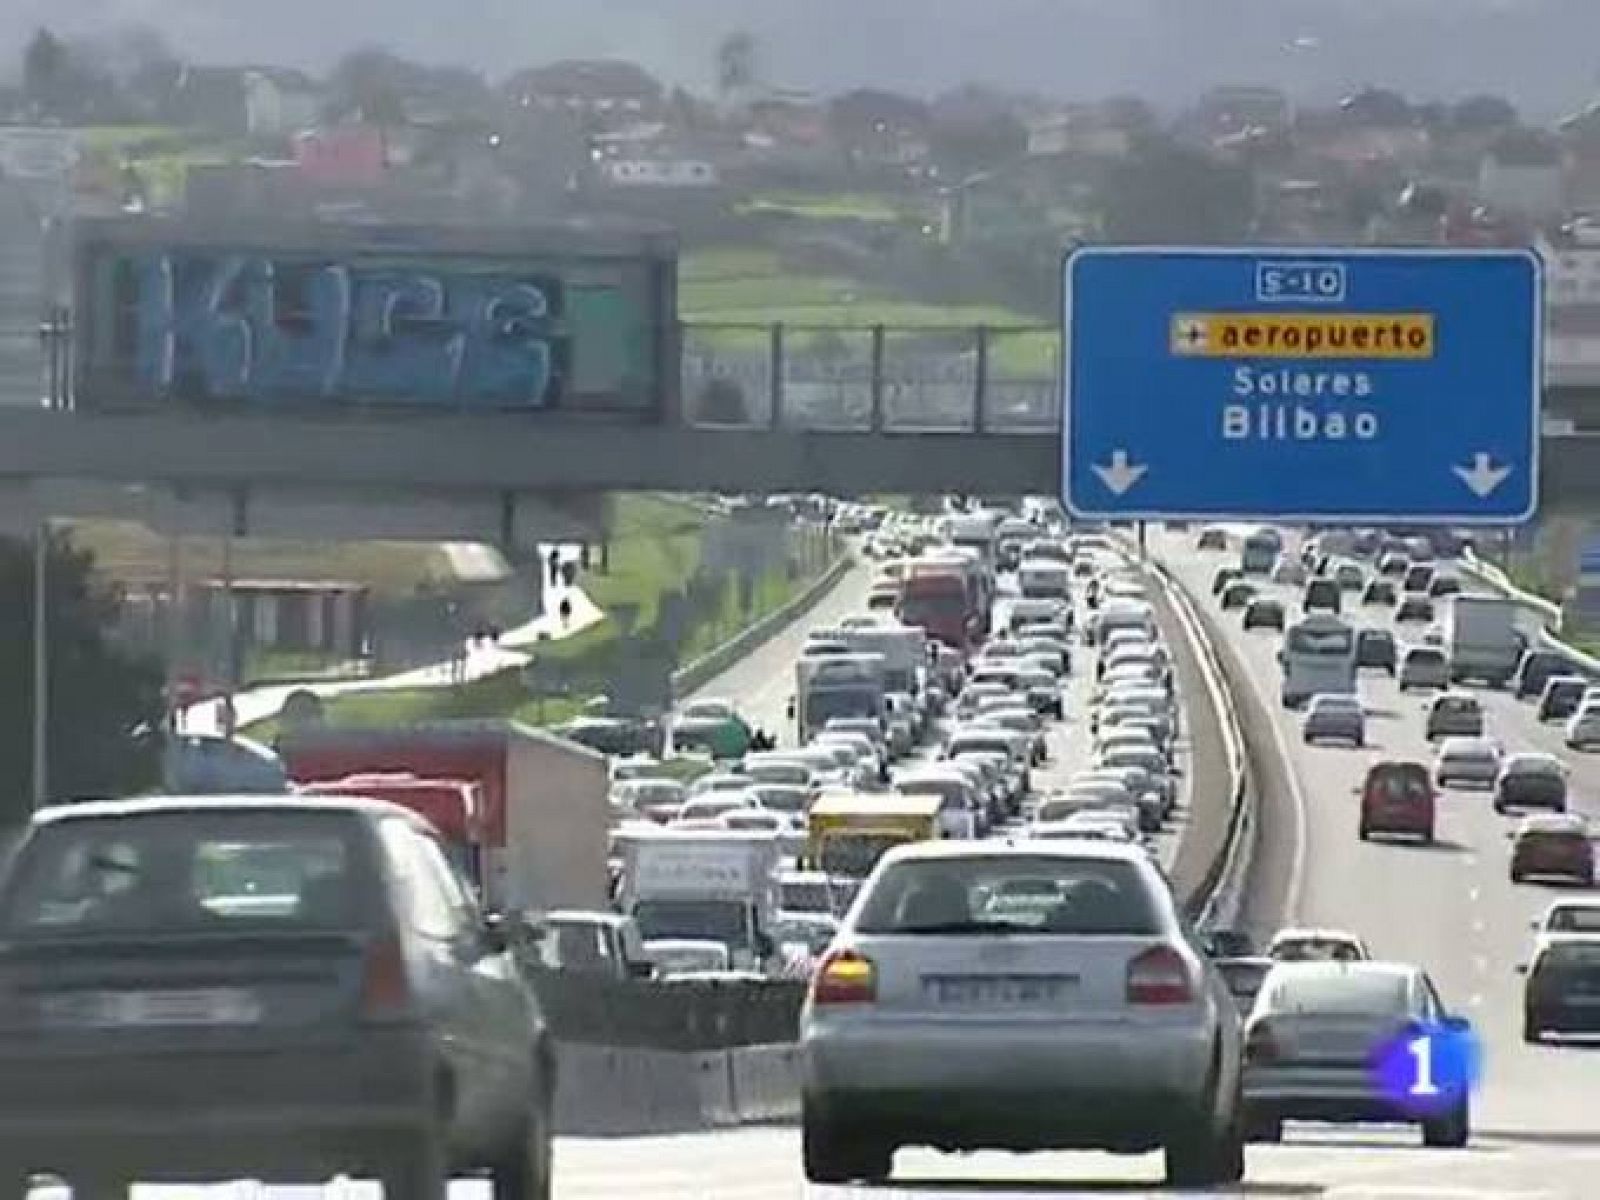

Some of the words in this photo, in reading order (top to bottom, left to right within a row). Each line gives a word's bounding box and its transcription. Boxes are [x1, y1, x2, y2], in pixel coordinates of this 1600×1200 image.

[1264, 270, 1339, 293] S-10
[1223, 322, 1427, 351] aeropuerto
[1233, 366, 1372, 397] Solares
[1223, 405, 1379, 440] Bilbao
